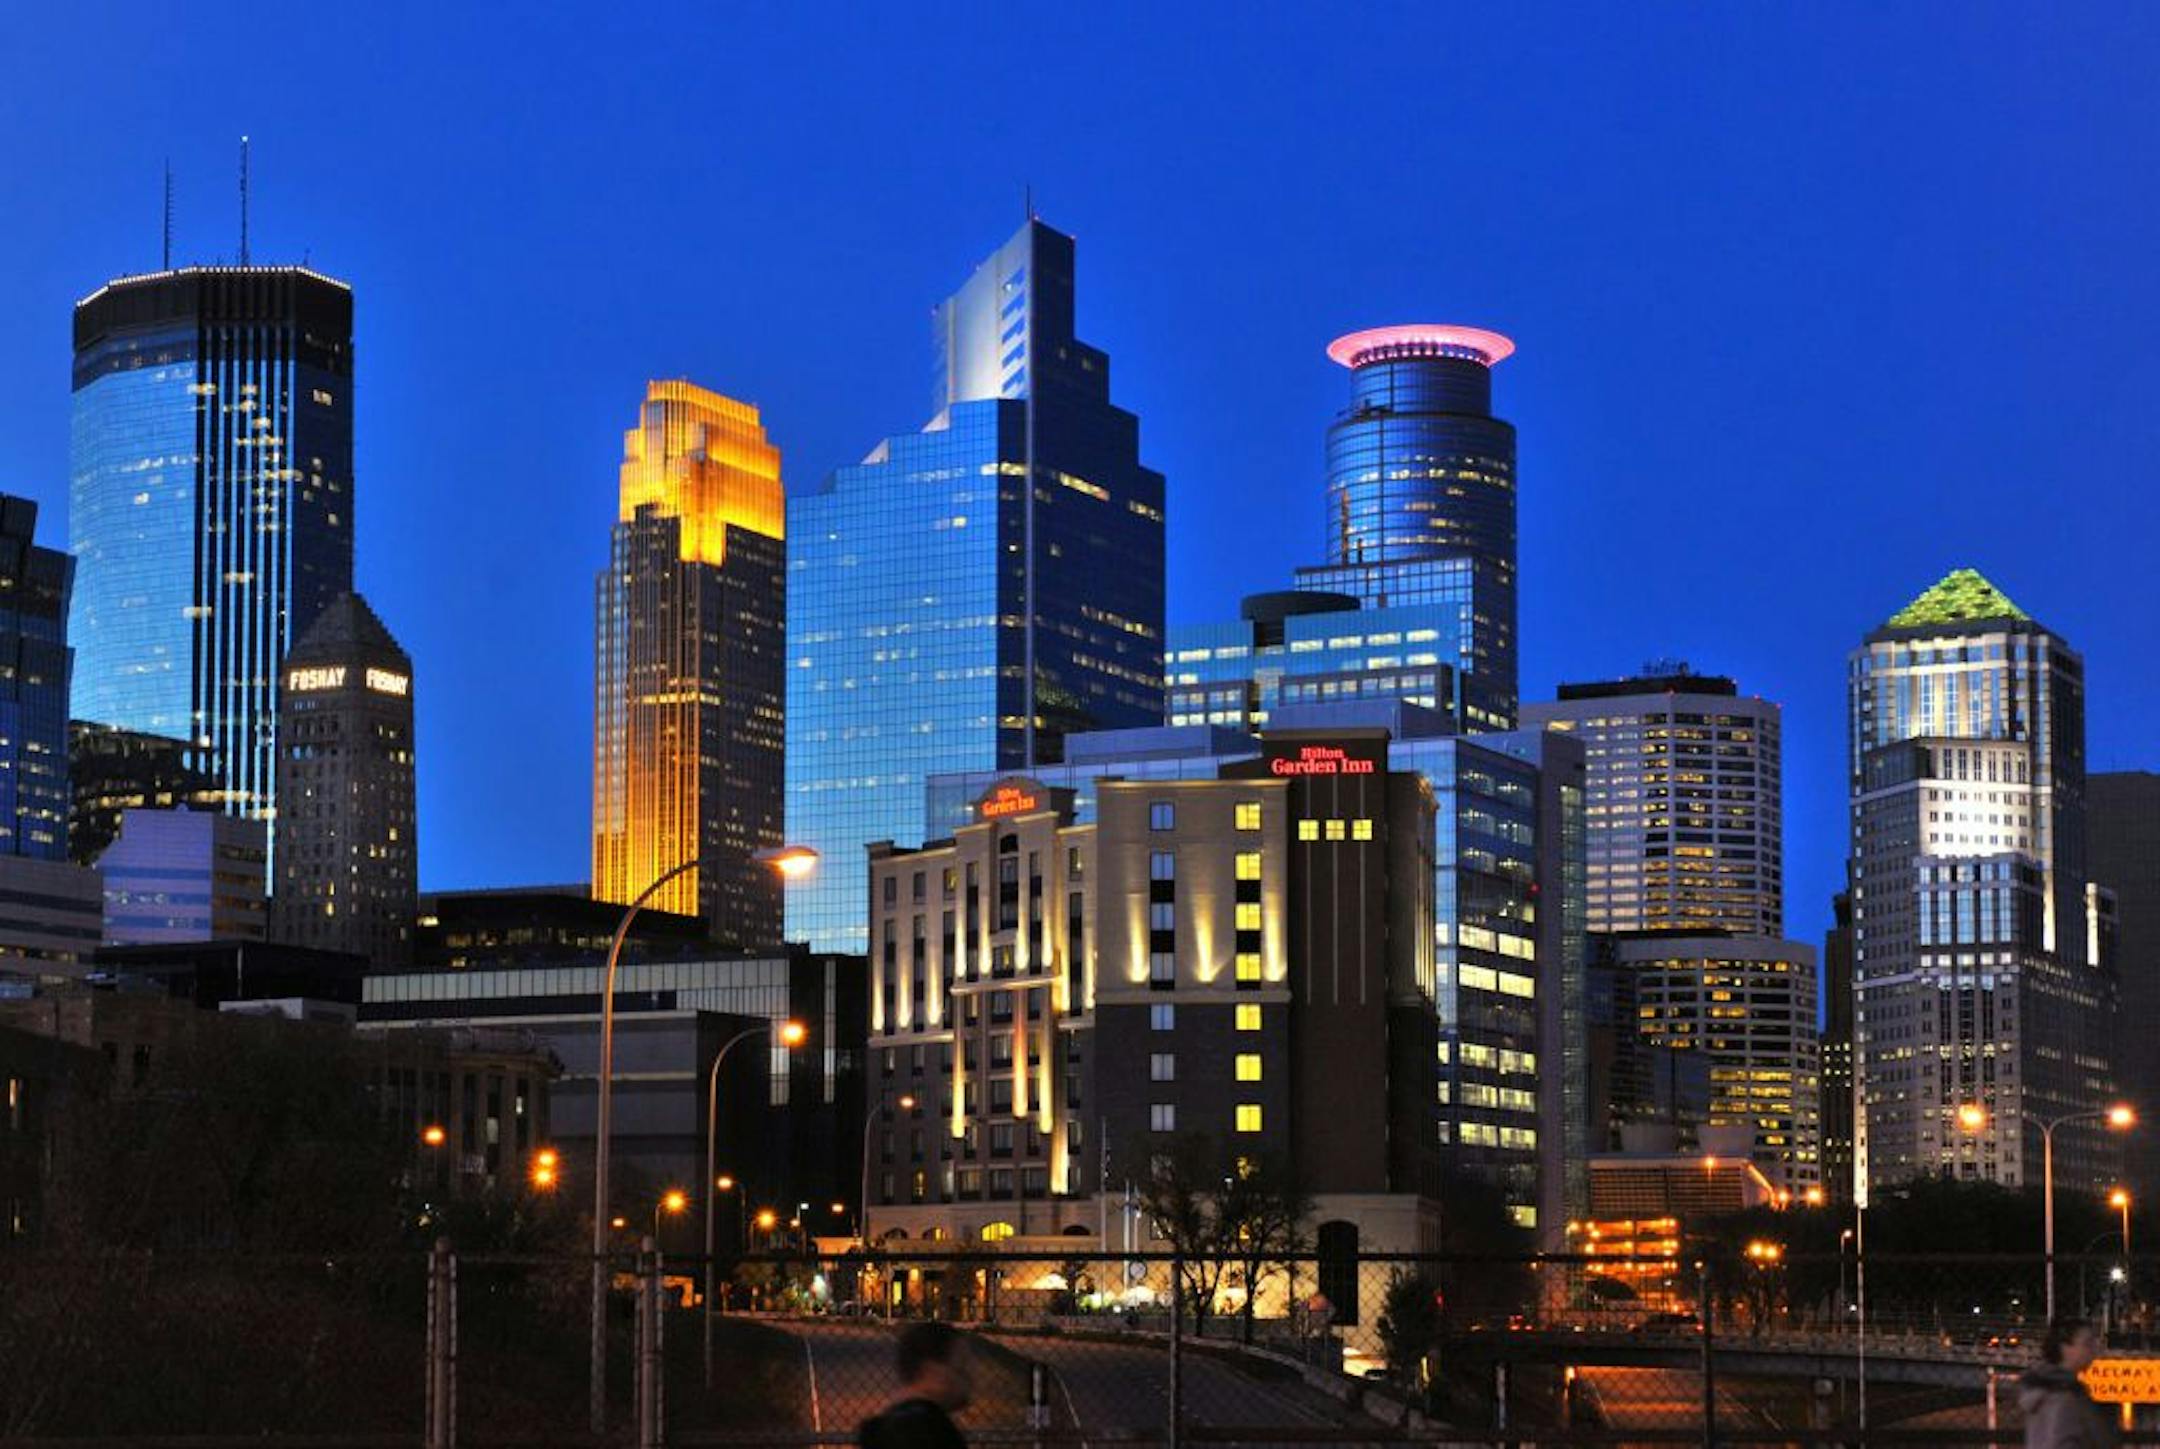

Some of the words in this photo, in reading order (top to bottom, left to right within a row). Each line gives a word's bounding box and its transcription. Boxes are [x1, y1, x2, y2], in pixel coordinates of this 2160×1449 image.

[290, 667, 346, 691] FOSHAY
[366, 667, 408, 695] FOSHAY
[1301, 746, 1344, 760] Hilton
[1272, 758, 1337, 775] Garden
[1341, 758, 1374, 773] Inn
